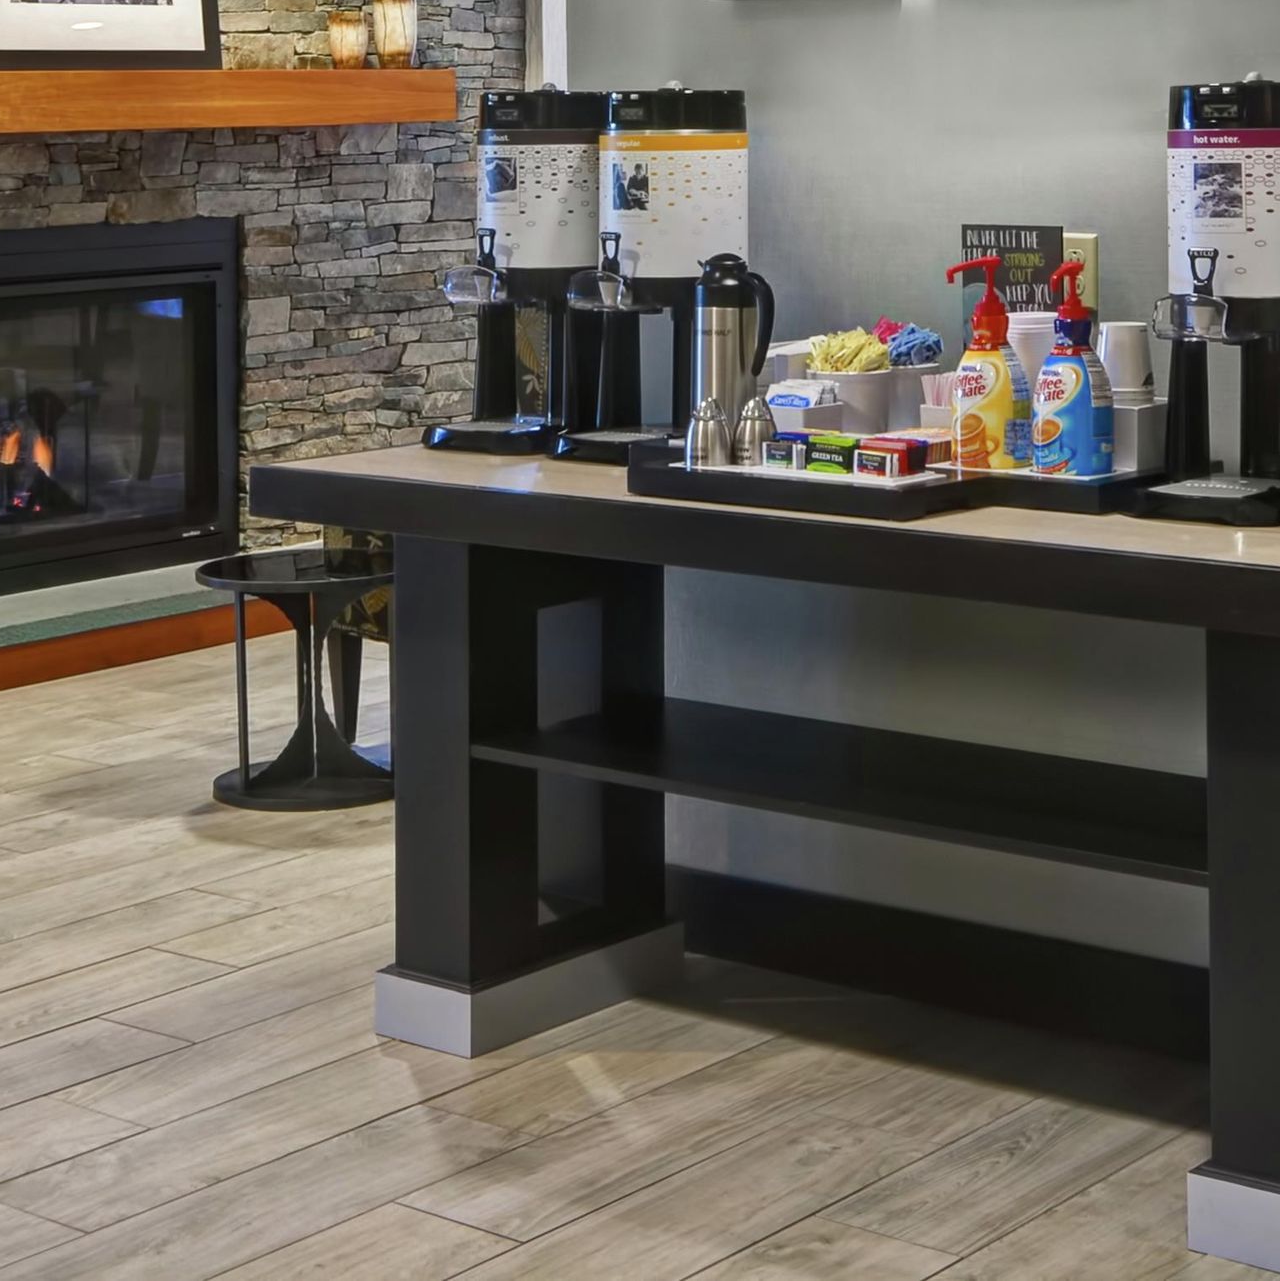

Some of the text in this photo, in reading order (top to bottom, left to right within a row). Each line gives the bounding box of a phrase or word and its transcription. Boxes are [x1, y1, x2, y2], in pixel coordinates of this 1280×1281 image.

[1193, 134, 1240, 144] hot water.
[966, 229, 1040, 249] NEVER LET THE
[1003, 252, 1046, 267] STRIKING
[1009, 268, 1034, 283] OUT
[1005, 283, 1054, 304] KEEP YOU
[811, 451, 843, 462] GREEN TEA
